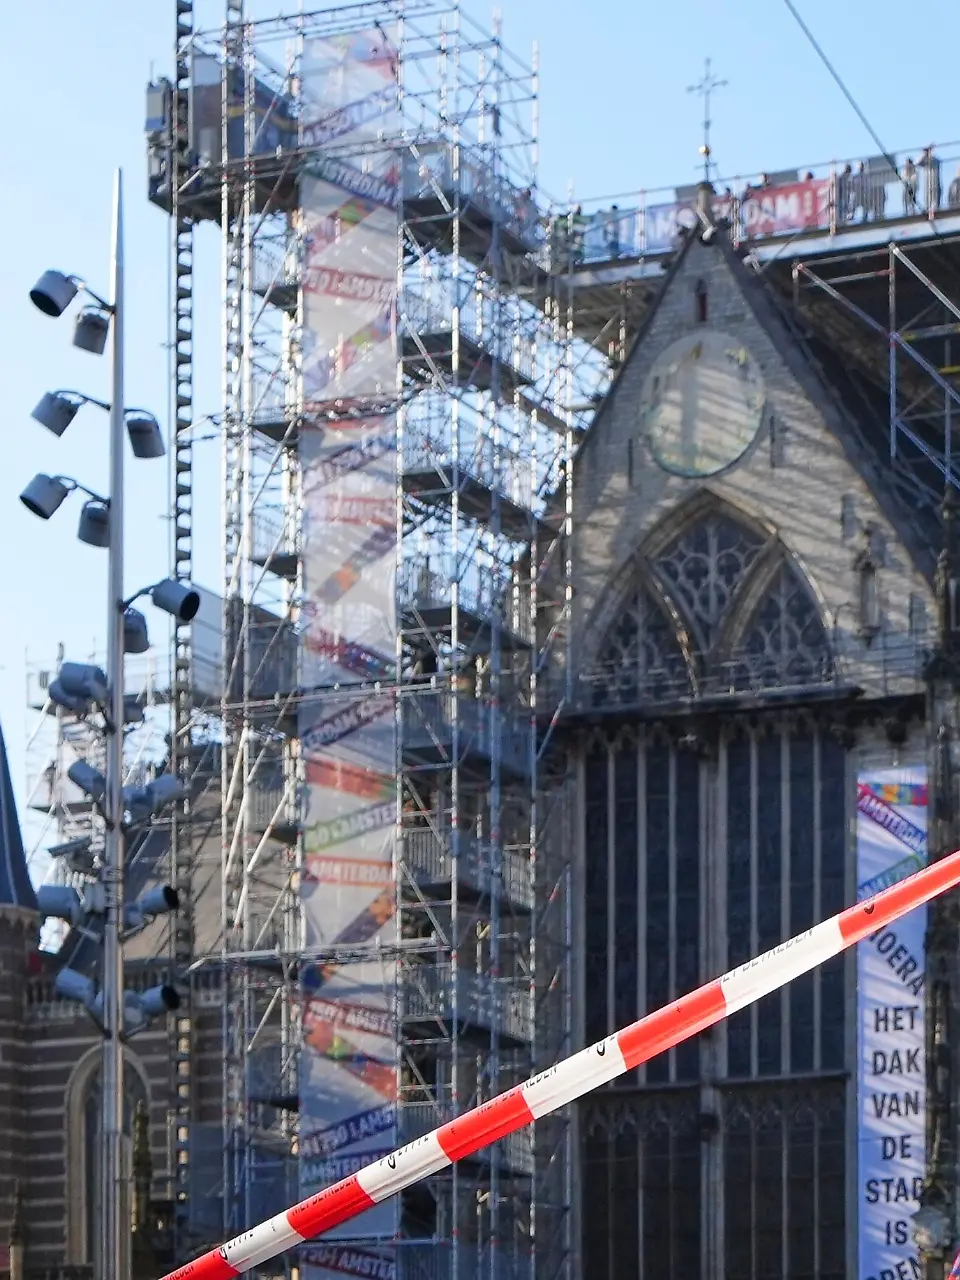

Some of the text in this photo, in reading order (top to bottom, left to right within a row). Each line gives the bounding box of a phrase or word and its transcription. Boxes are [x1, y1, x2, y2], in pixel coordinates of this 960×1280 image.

[874, 1006, 920, 1032] HET
[872, 1048, 920, 1076] DAK
[872, 1091, 920, 1119] VAN
[881, 1134, 912, 1160] DE
[884, 1220, 908, 1246] IS
